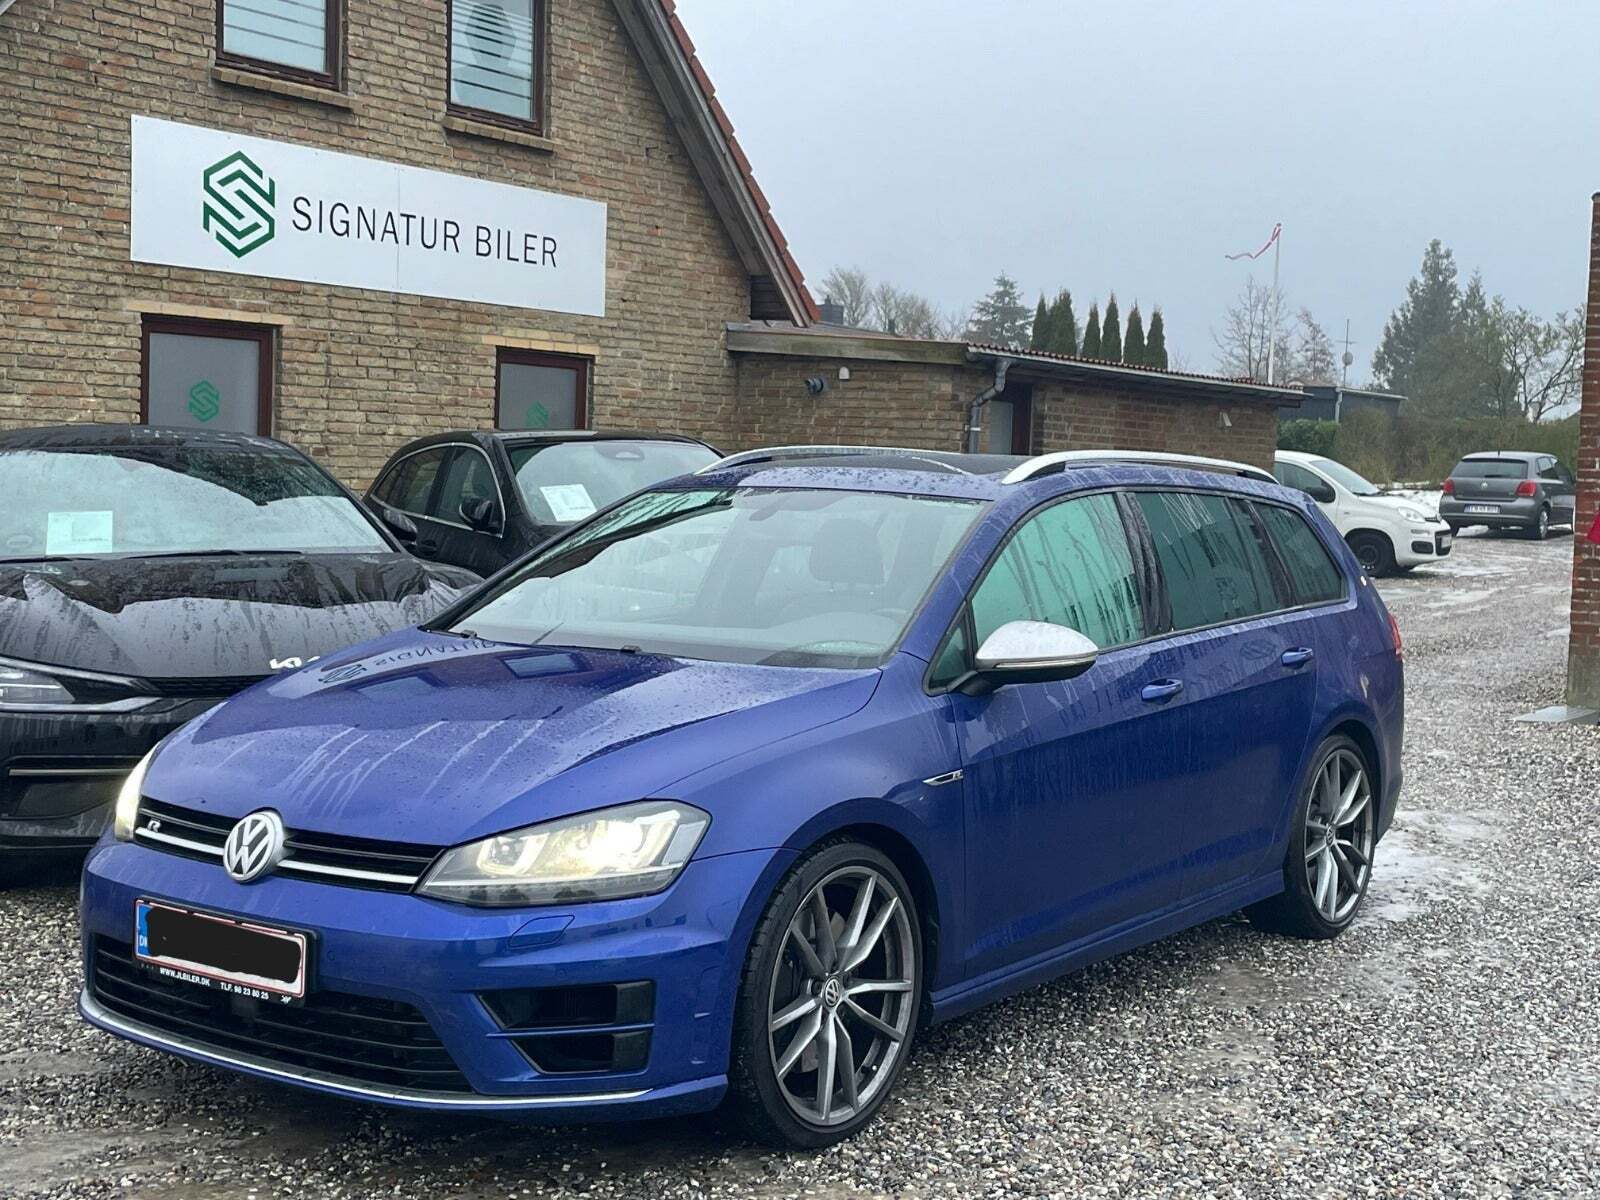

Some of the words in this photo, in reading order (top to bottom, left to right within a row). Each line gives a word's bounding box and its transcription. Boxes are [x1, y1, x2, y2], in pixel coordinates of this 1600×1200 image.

[292, 196, 460, 253] SIGNATUR
[475, 225, 557, 267] BILER
[148, 819, 161, 833] R
